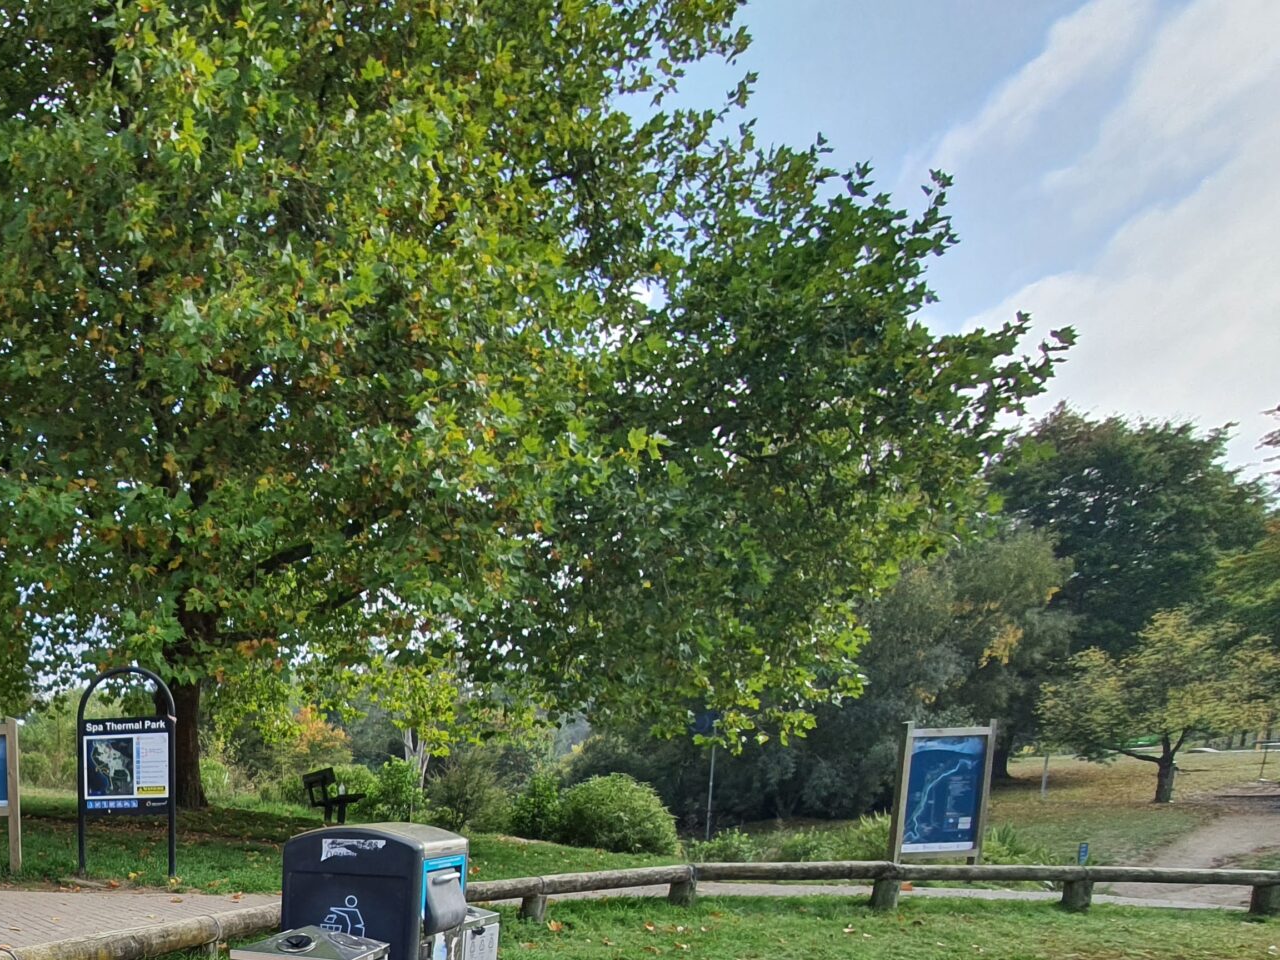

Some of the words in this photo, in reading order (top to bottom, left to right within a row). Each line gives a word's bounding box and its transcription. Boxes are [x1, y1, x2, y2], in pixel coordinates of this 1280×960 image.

[86, 722, 103, 732] Spa
[105, 720, 142, 730] Thermal
[144, 720, 166, 729] Park
